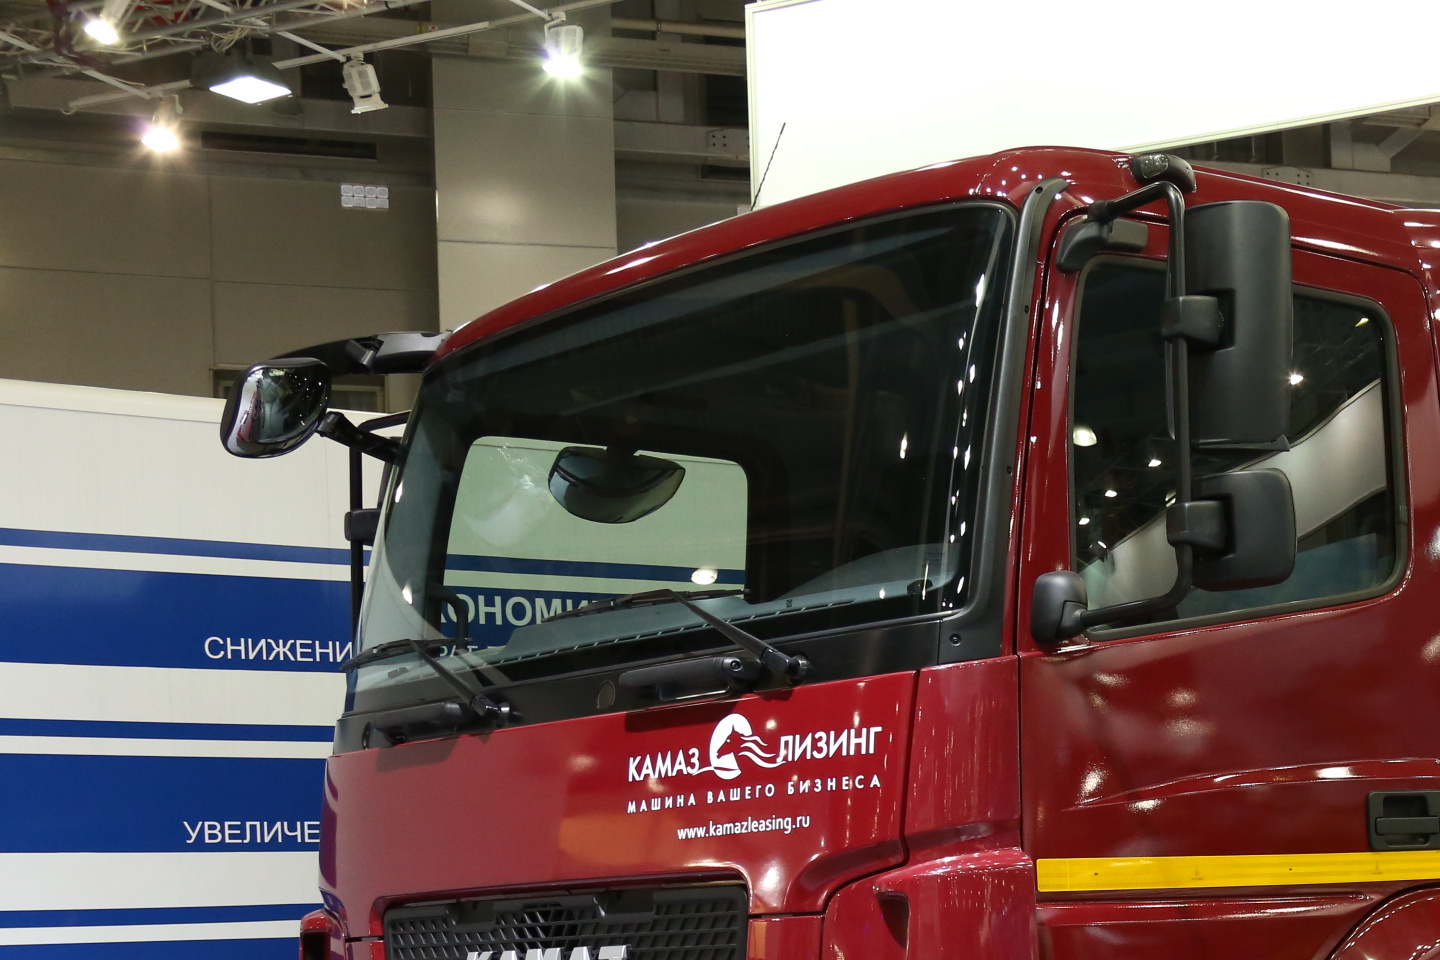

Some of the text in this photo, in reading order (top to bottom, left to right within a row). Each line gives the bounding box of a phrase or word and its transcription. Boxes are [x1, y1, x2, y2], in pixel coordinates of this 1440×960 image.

[628, 726, 883, 783] КАМАЗ ЛИЗИНГ
[627, 774, 881, 814] МАШИНА ВАШЕГО БИЗНЕСА
[183, 821, 321, 844] УВЕЛИЧЕ
[677, 815, 811, 840] www.kamazleasing.ru
